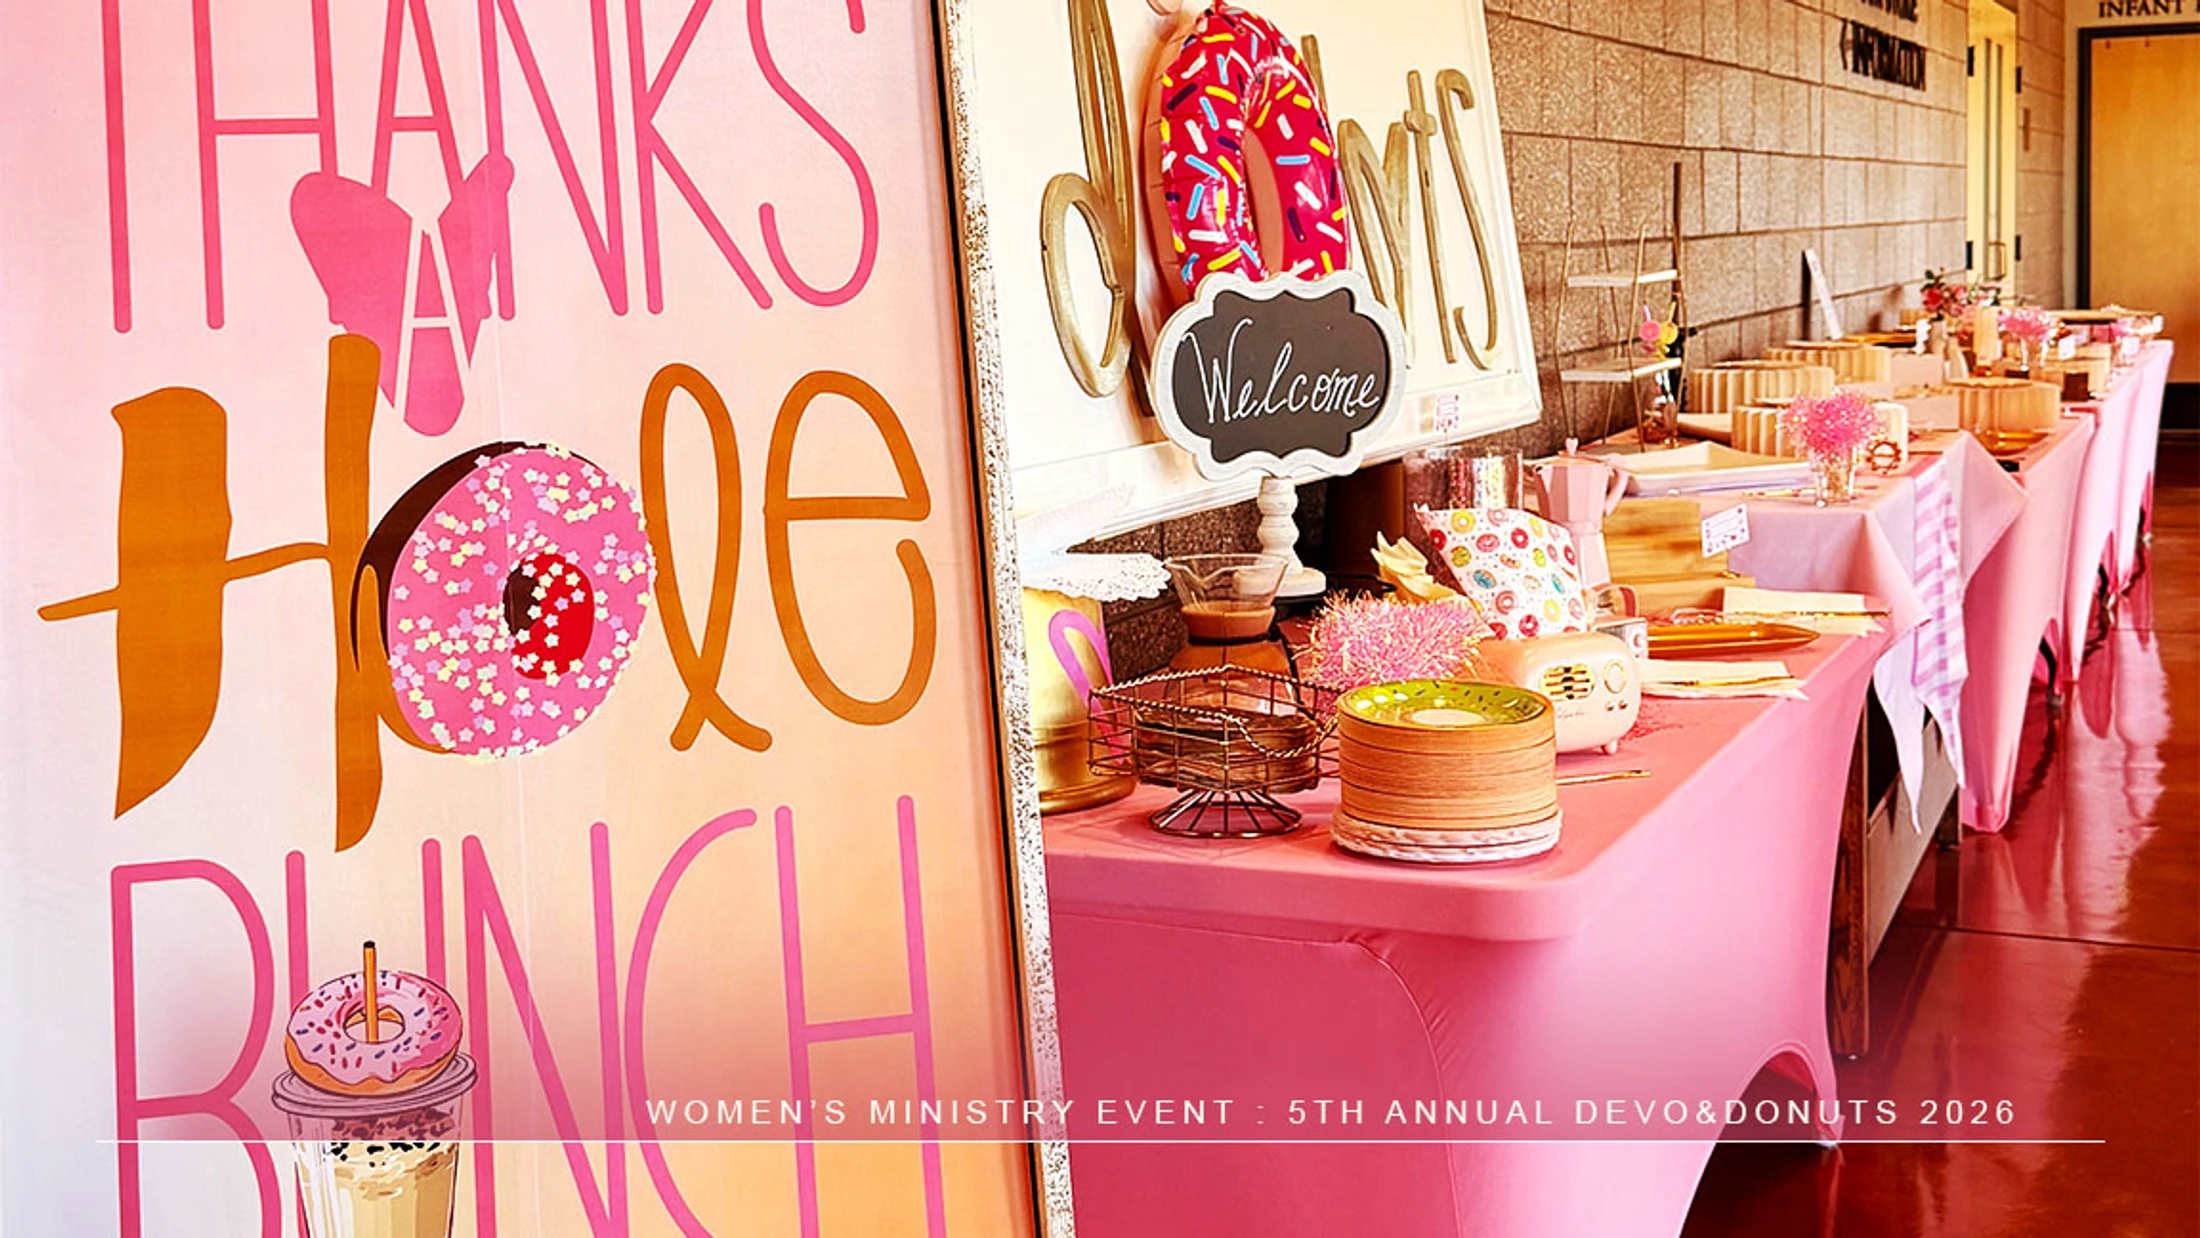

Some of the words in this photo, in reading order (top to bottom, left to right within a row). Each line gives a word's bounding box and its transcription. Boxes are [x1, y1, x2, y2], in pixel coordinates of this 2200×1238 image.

[2099, 0, 2183, 18] INFANT
[104, 0, 879, 333] THANKS
[1180, 317, 1380, 425] Welcome
[38, 333, 937, 852] Hole
